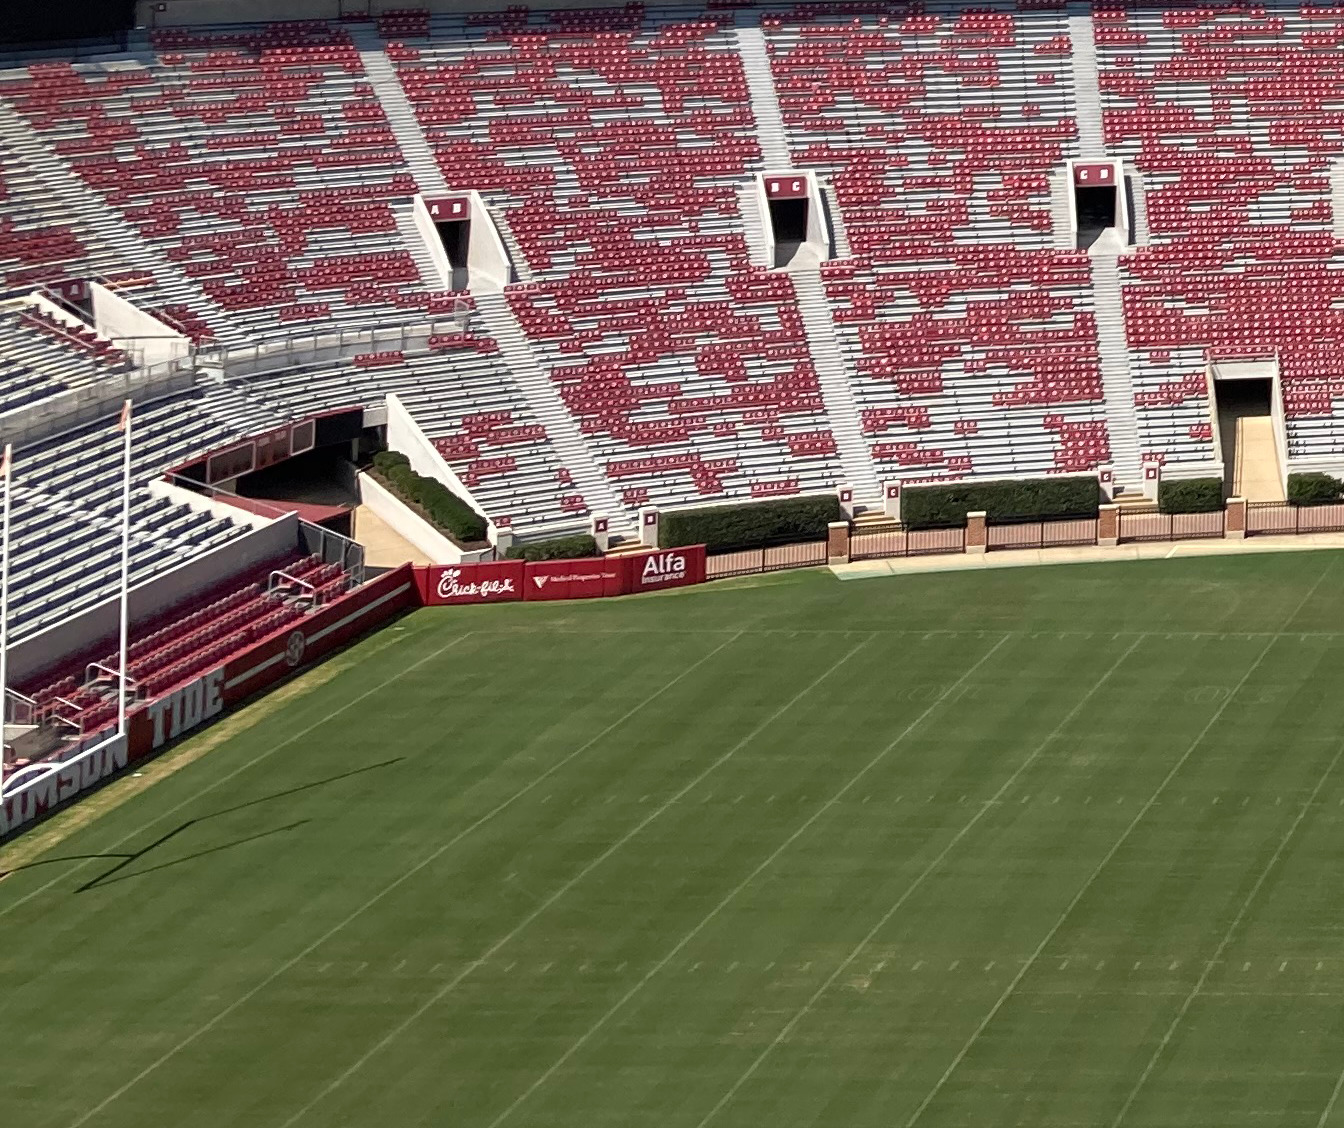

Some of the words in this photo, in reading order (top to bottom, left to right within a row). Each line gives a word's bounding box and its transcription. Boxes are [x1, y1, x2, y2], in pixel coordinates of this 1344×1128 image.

[1080, 170, 1087, 179] C
[793, 182, 800, 191] C
[431, 205, 439, 214] A
[643, 553, 686, 576] Alfa
[642, 571, 686, 584] Insurance
[148, 668, 225, 750] TIDE
